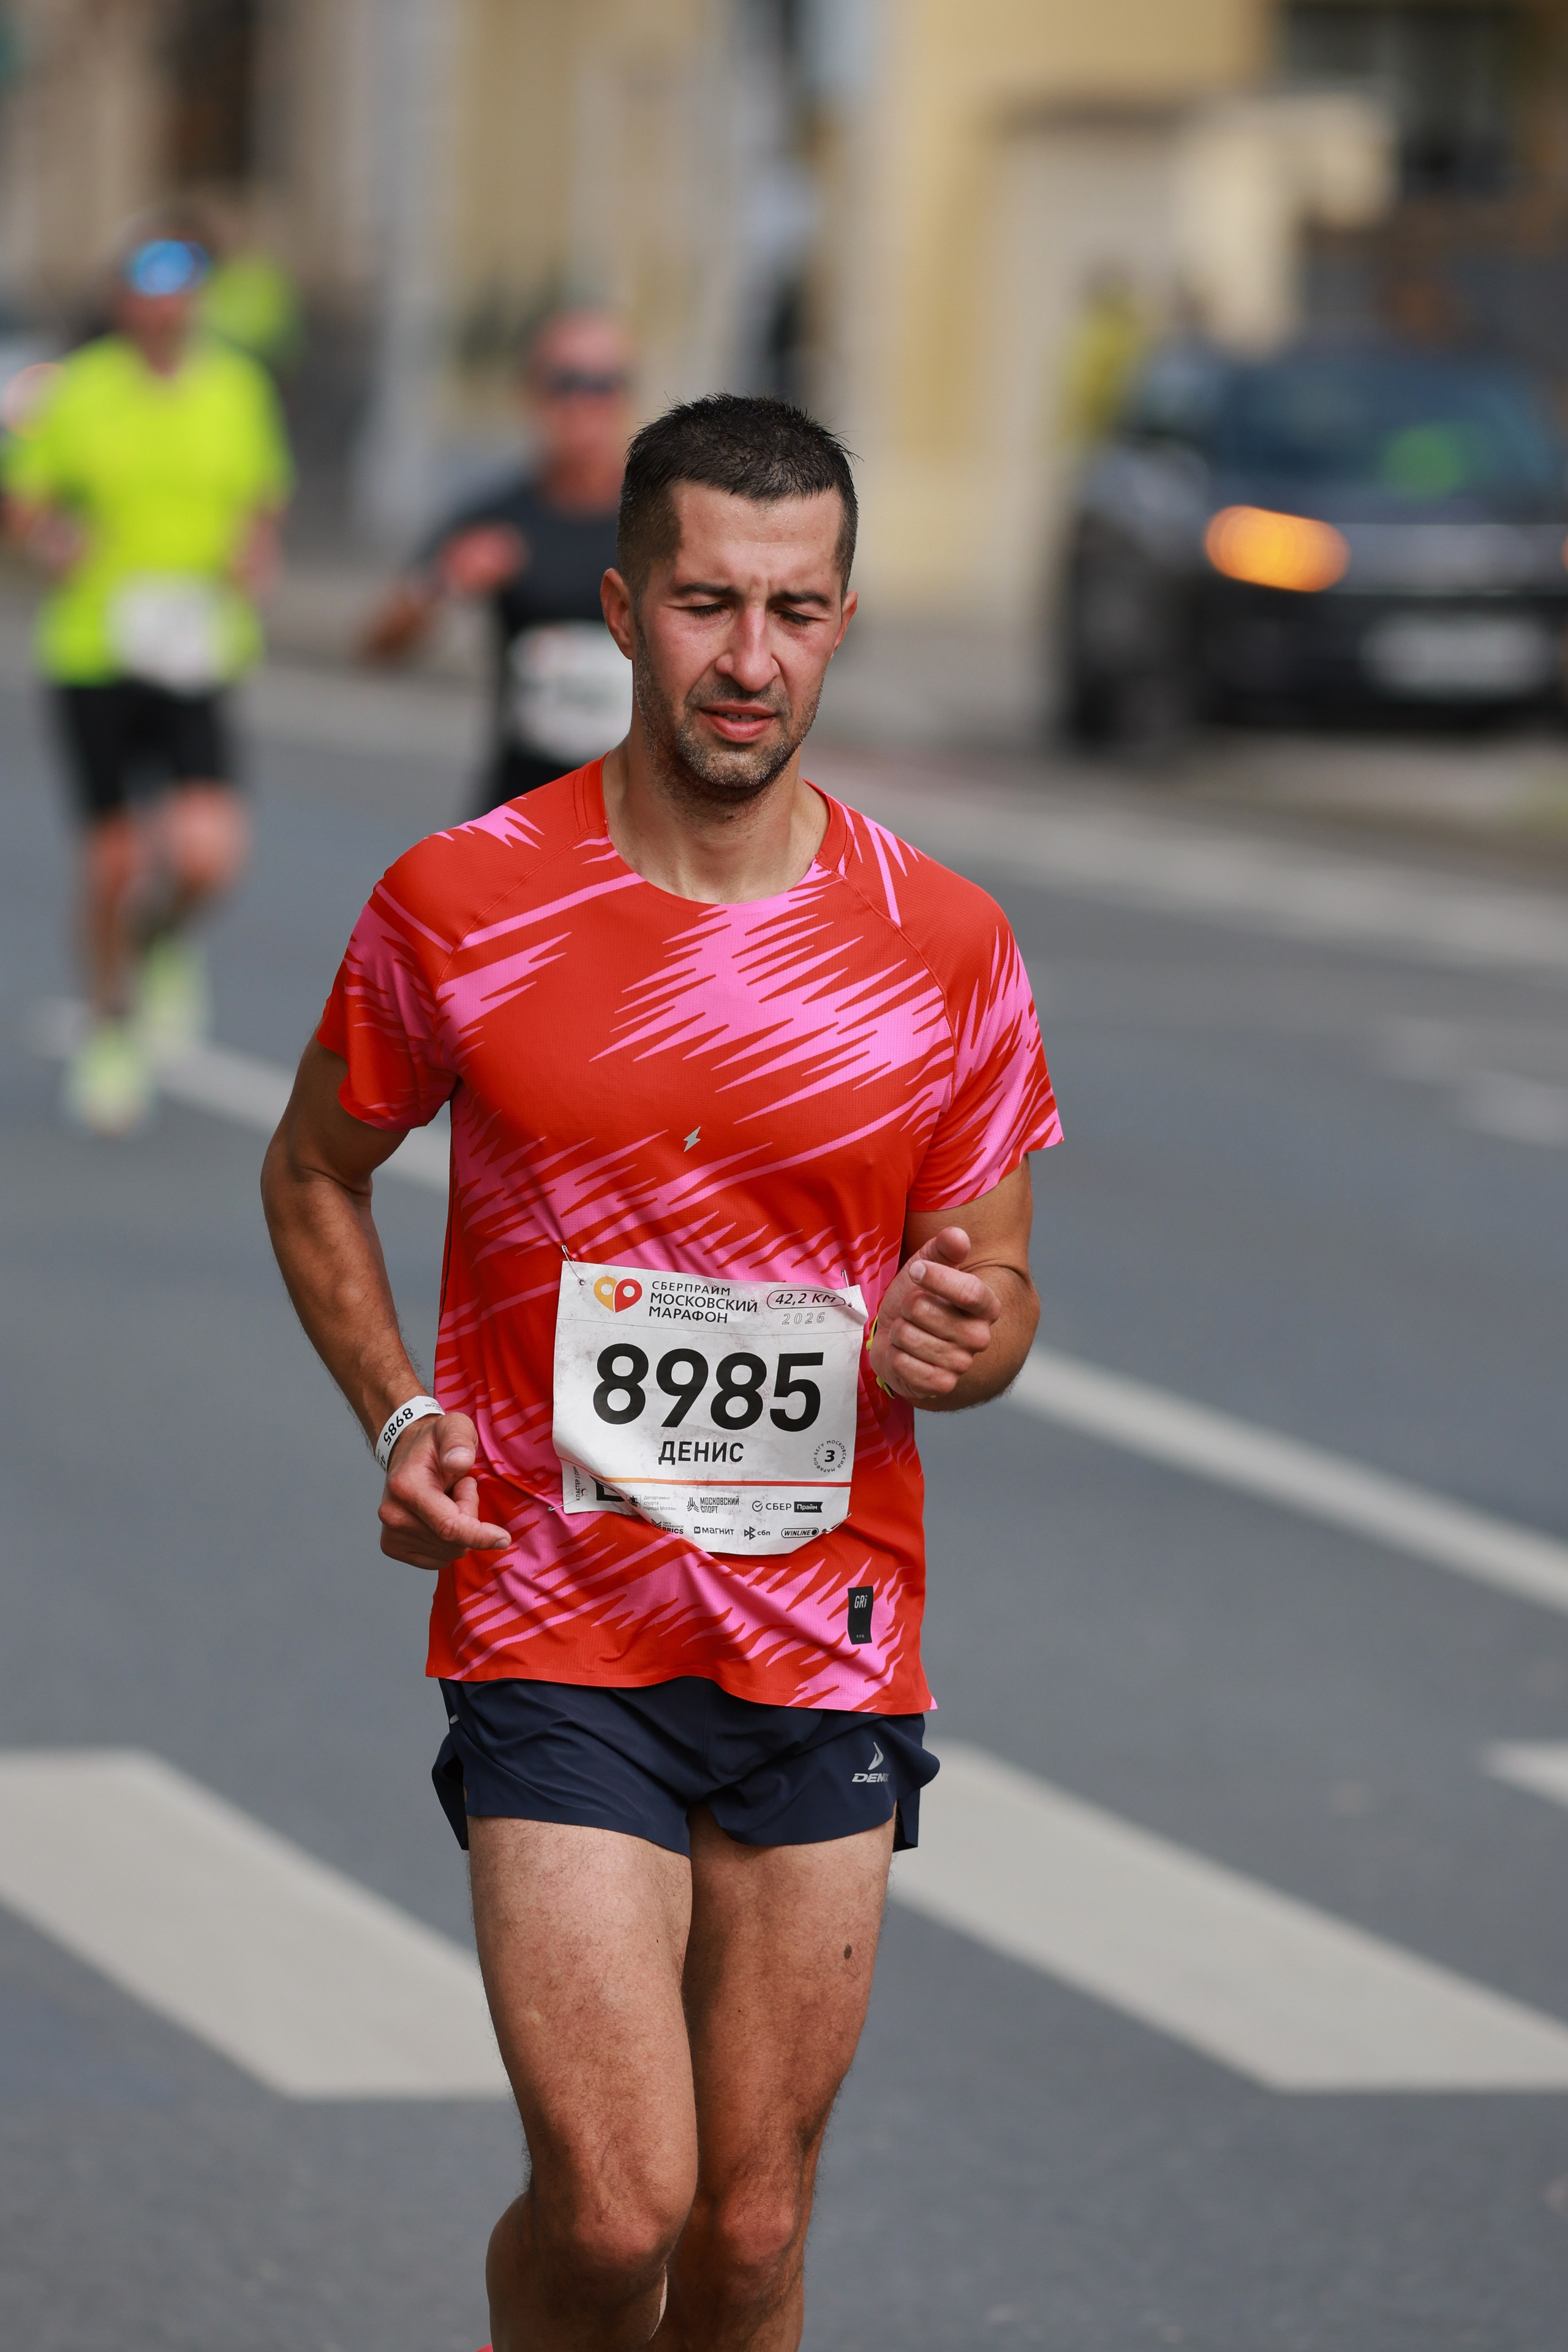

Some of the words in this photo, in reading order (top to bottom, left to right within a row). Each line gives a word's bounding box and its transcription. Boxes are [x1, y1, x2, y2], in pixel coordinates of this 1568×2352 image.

[652, 1281, 730, 1296] СБЕРПРАЙМ
[650, 1292, 758, 1313] МОСКОВСКИЙ
[775, 1293, 807, 1306] 42,2
[649, 1306, 728, 1324] МАРАФОН
[782, 1311, 826, 1325] 2026
[593, 1343, 824, 1432] 8985
[383, 1408, 414, 1446] 8985
[658, 1441, 744, 1465] ДЕНИС
[824, 1449, 835, 1463] 3
[699, 1496, 739, 1506] МОСКОВСКИЙ
[766, 1502, 792, 1511] СБЕР
